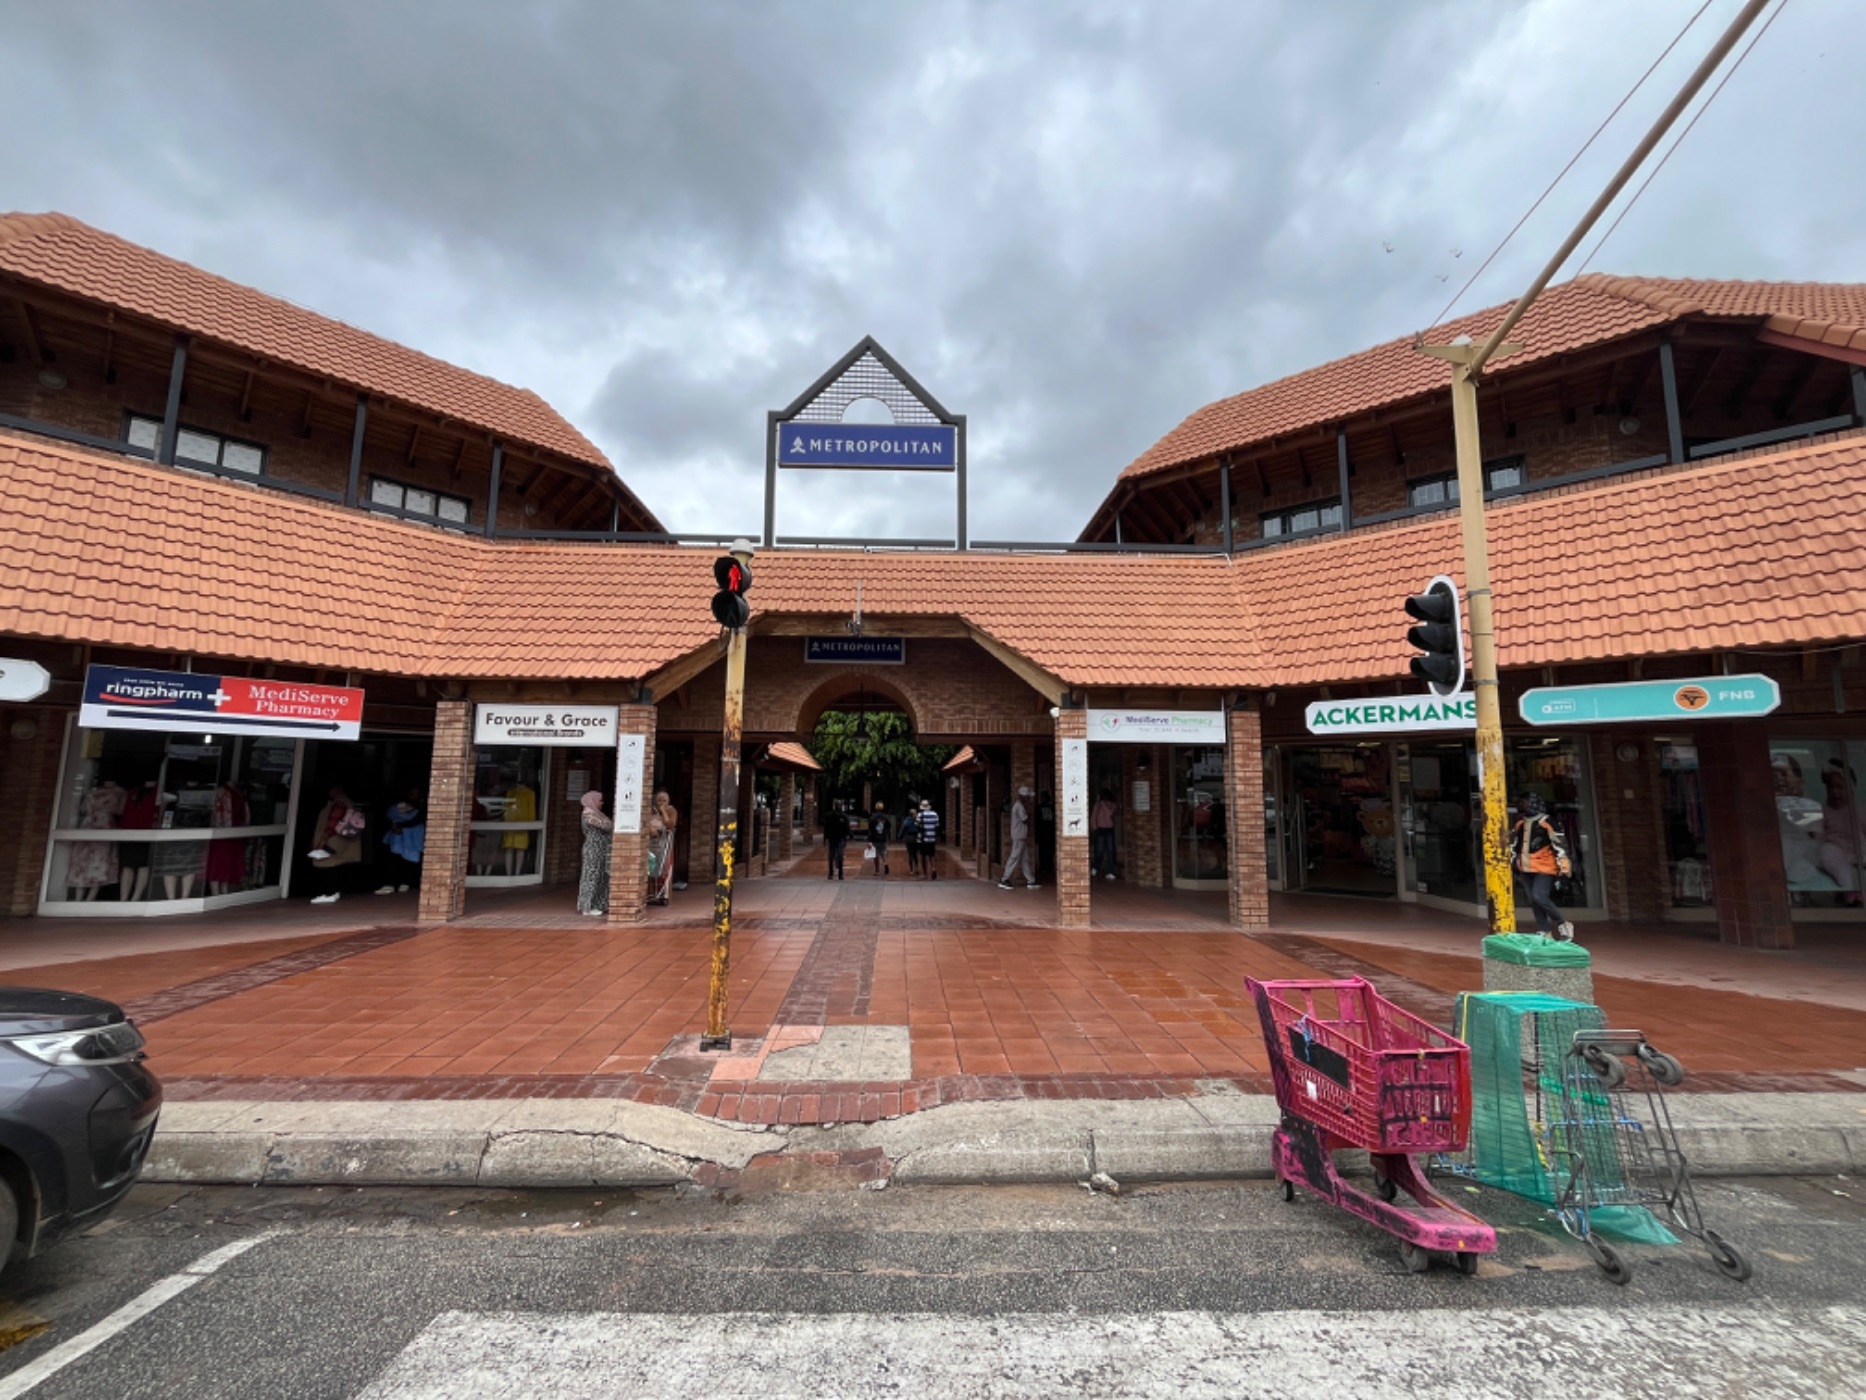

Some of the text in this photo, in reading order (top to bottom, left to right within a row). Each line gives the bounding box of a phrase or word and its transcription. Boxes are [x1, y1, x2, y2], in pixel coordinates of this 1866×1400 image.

[810, 439, 942, 454] METROPOLITAN
[822, 642, 900, 652] METROPOLITAN
[106, 682, 203, 699] ringpharm
[248, 685, 349, 706] MediServe
[1719, 690, 1755, 701] FNB
[255, 700, 340, 719] Pharmacy
[1312, 700, 1477, 727] ACKERMANS
[485, 712, 608, 727] Favour & Grace
[1125, 716, 1213, 727] MediServe Pharmacy
